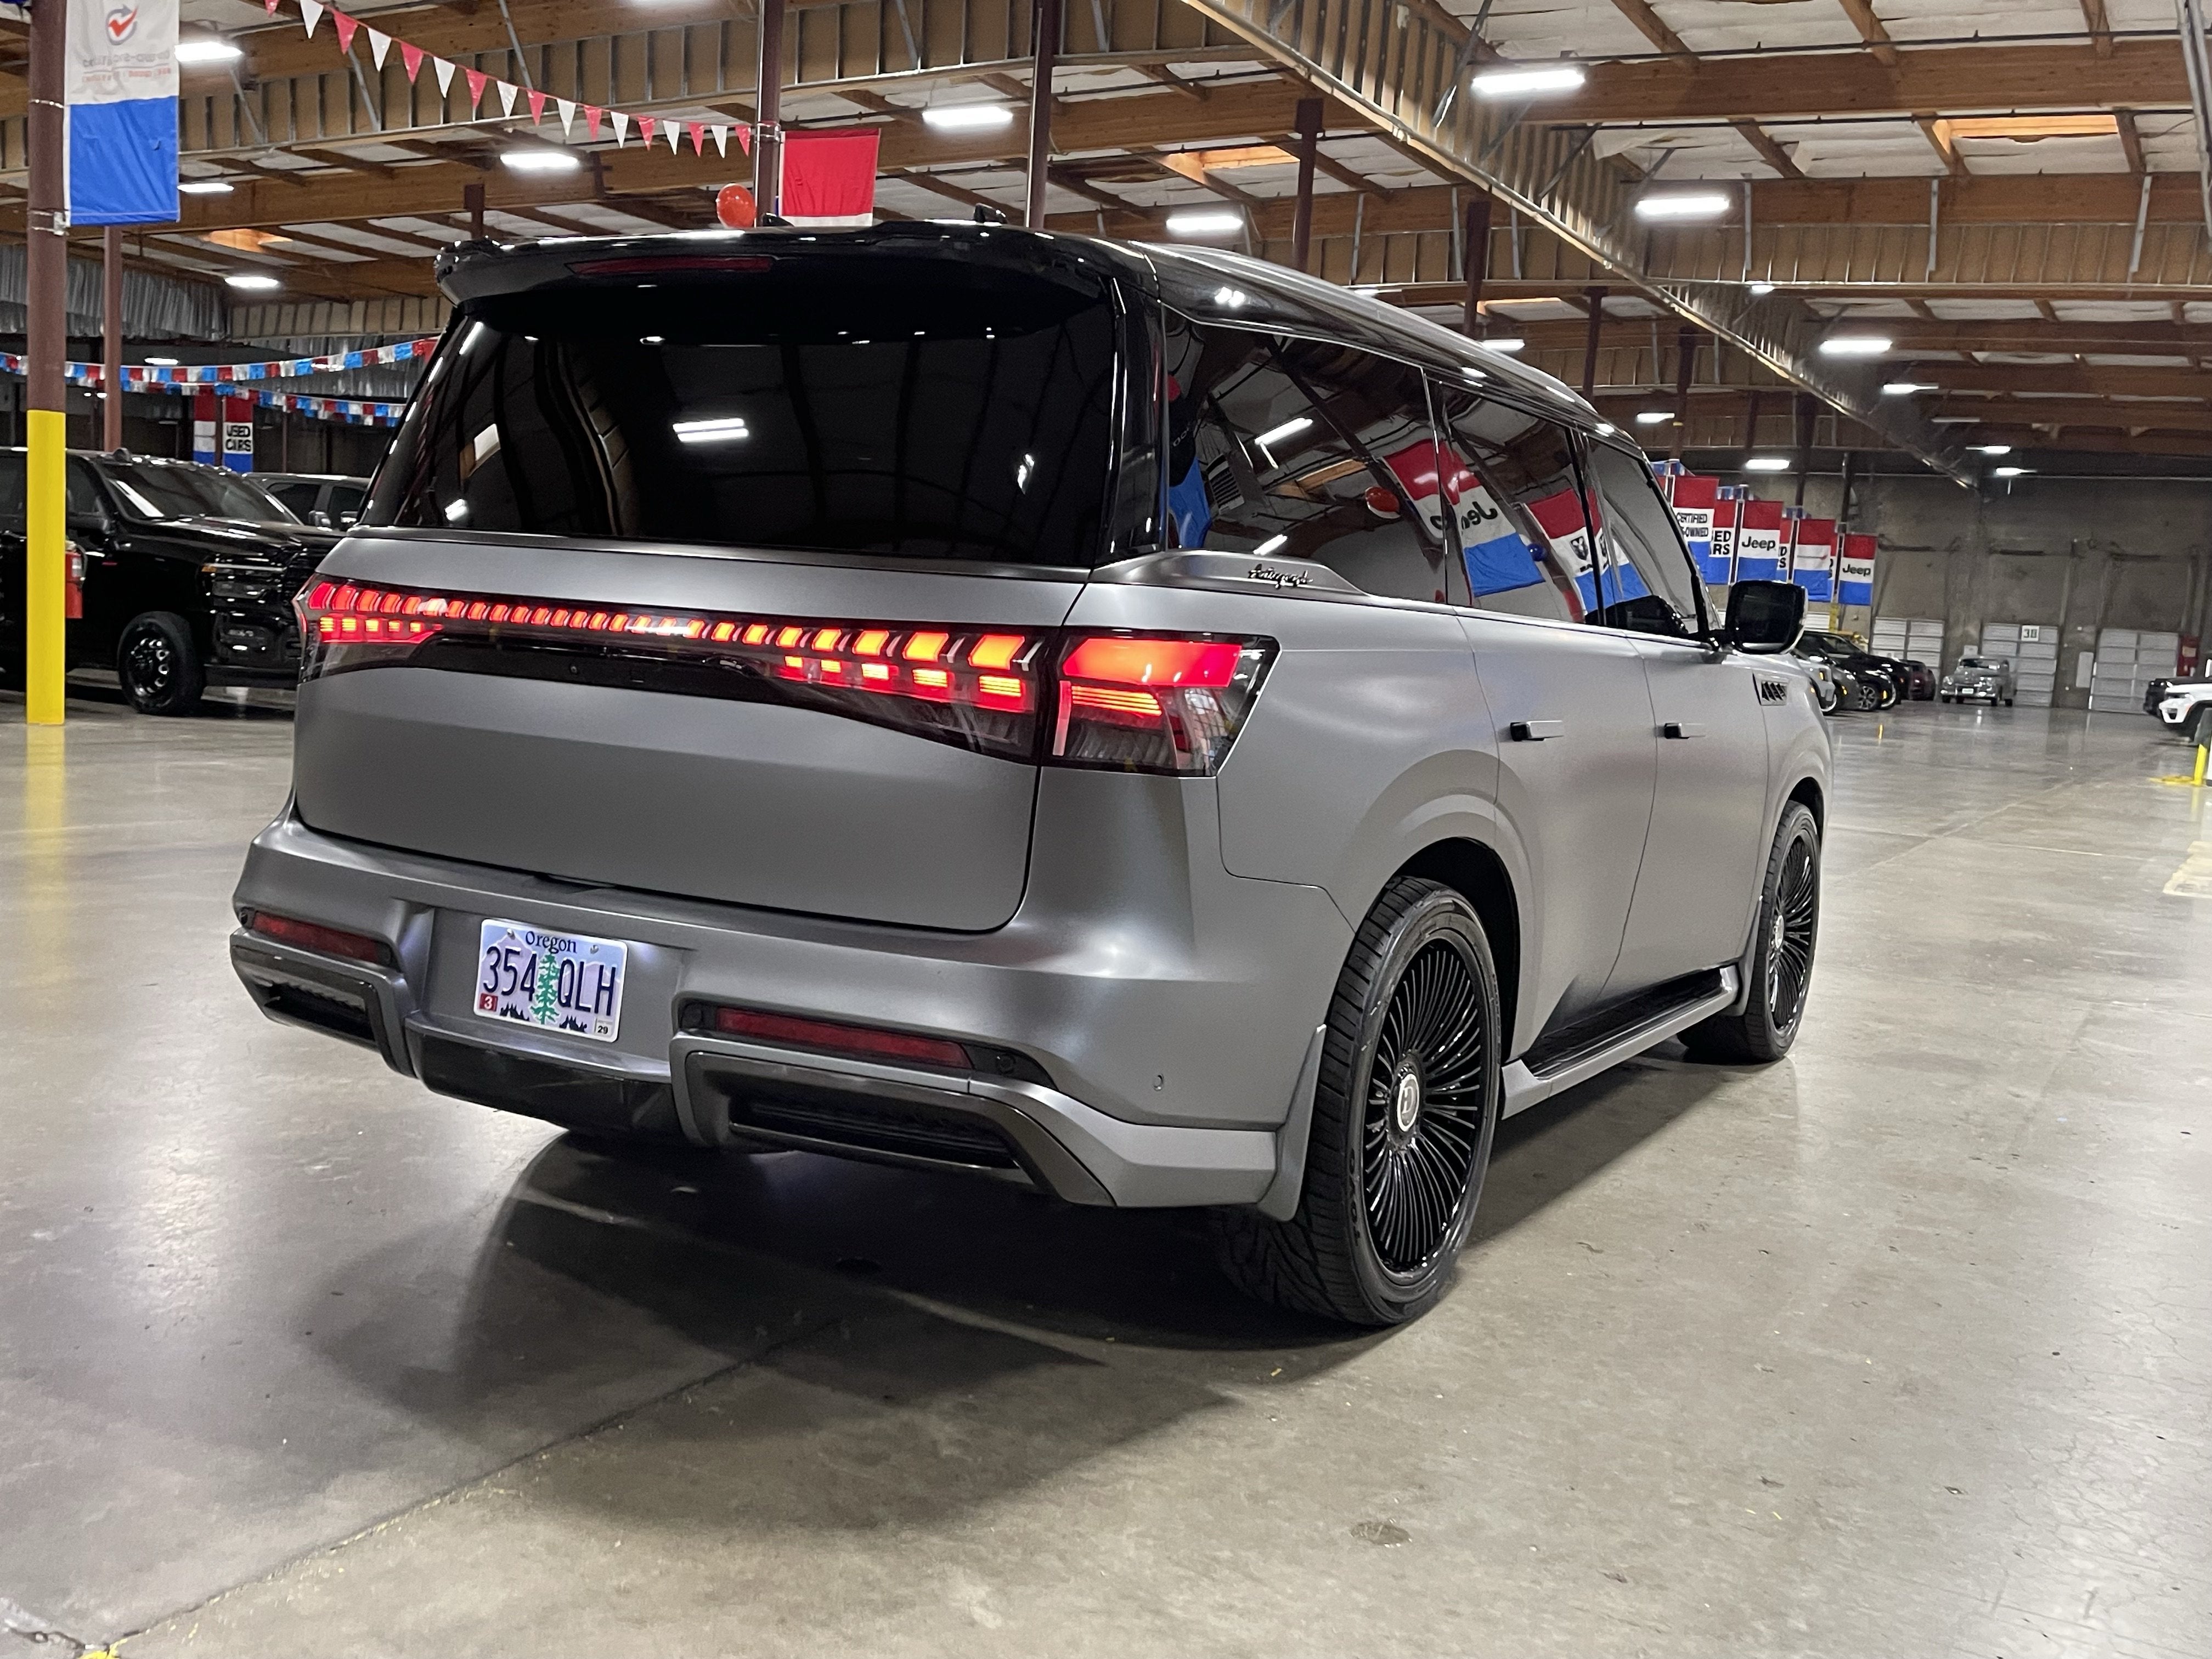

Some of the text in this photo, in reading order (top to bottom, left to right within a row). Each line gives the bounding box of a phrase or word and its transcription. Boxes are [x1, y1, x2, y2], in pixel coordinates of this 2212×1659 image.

[1741, 536, 1776, 551] Jeep
[1842, 563, 1871, 577] Jeep
[525, 930, 578, 955] Oregon
[483, 945, 617, 1017] 354 QLH
[483, 995, 493, 1010] 3
[597, 1025, 609, 1035] 29
